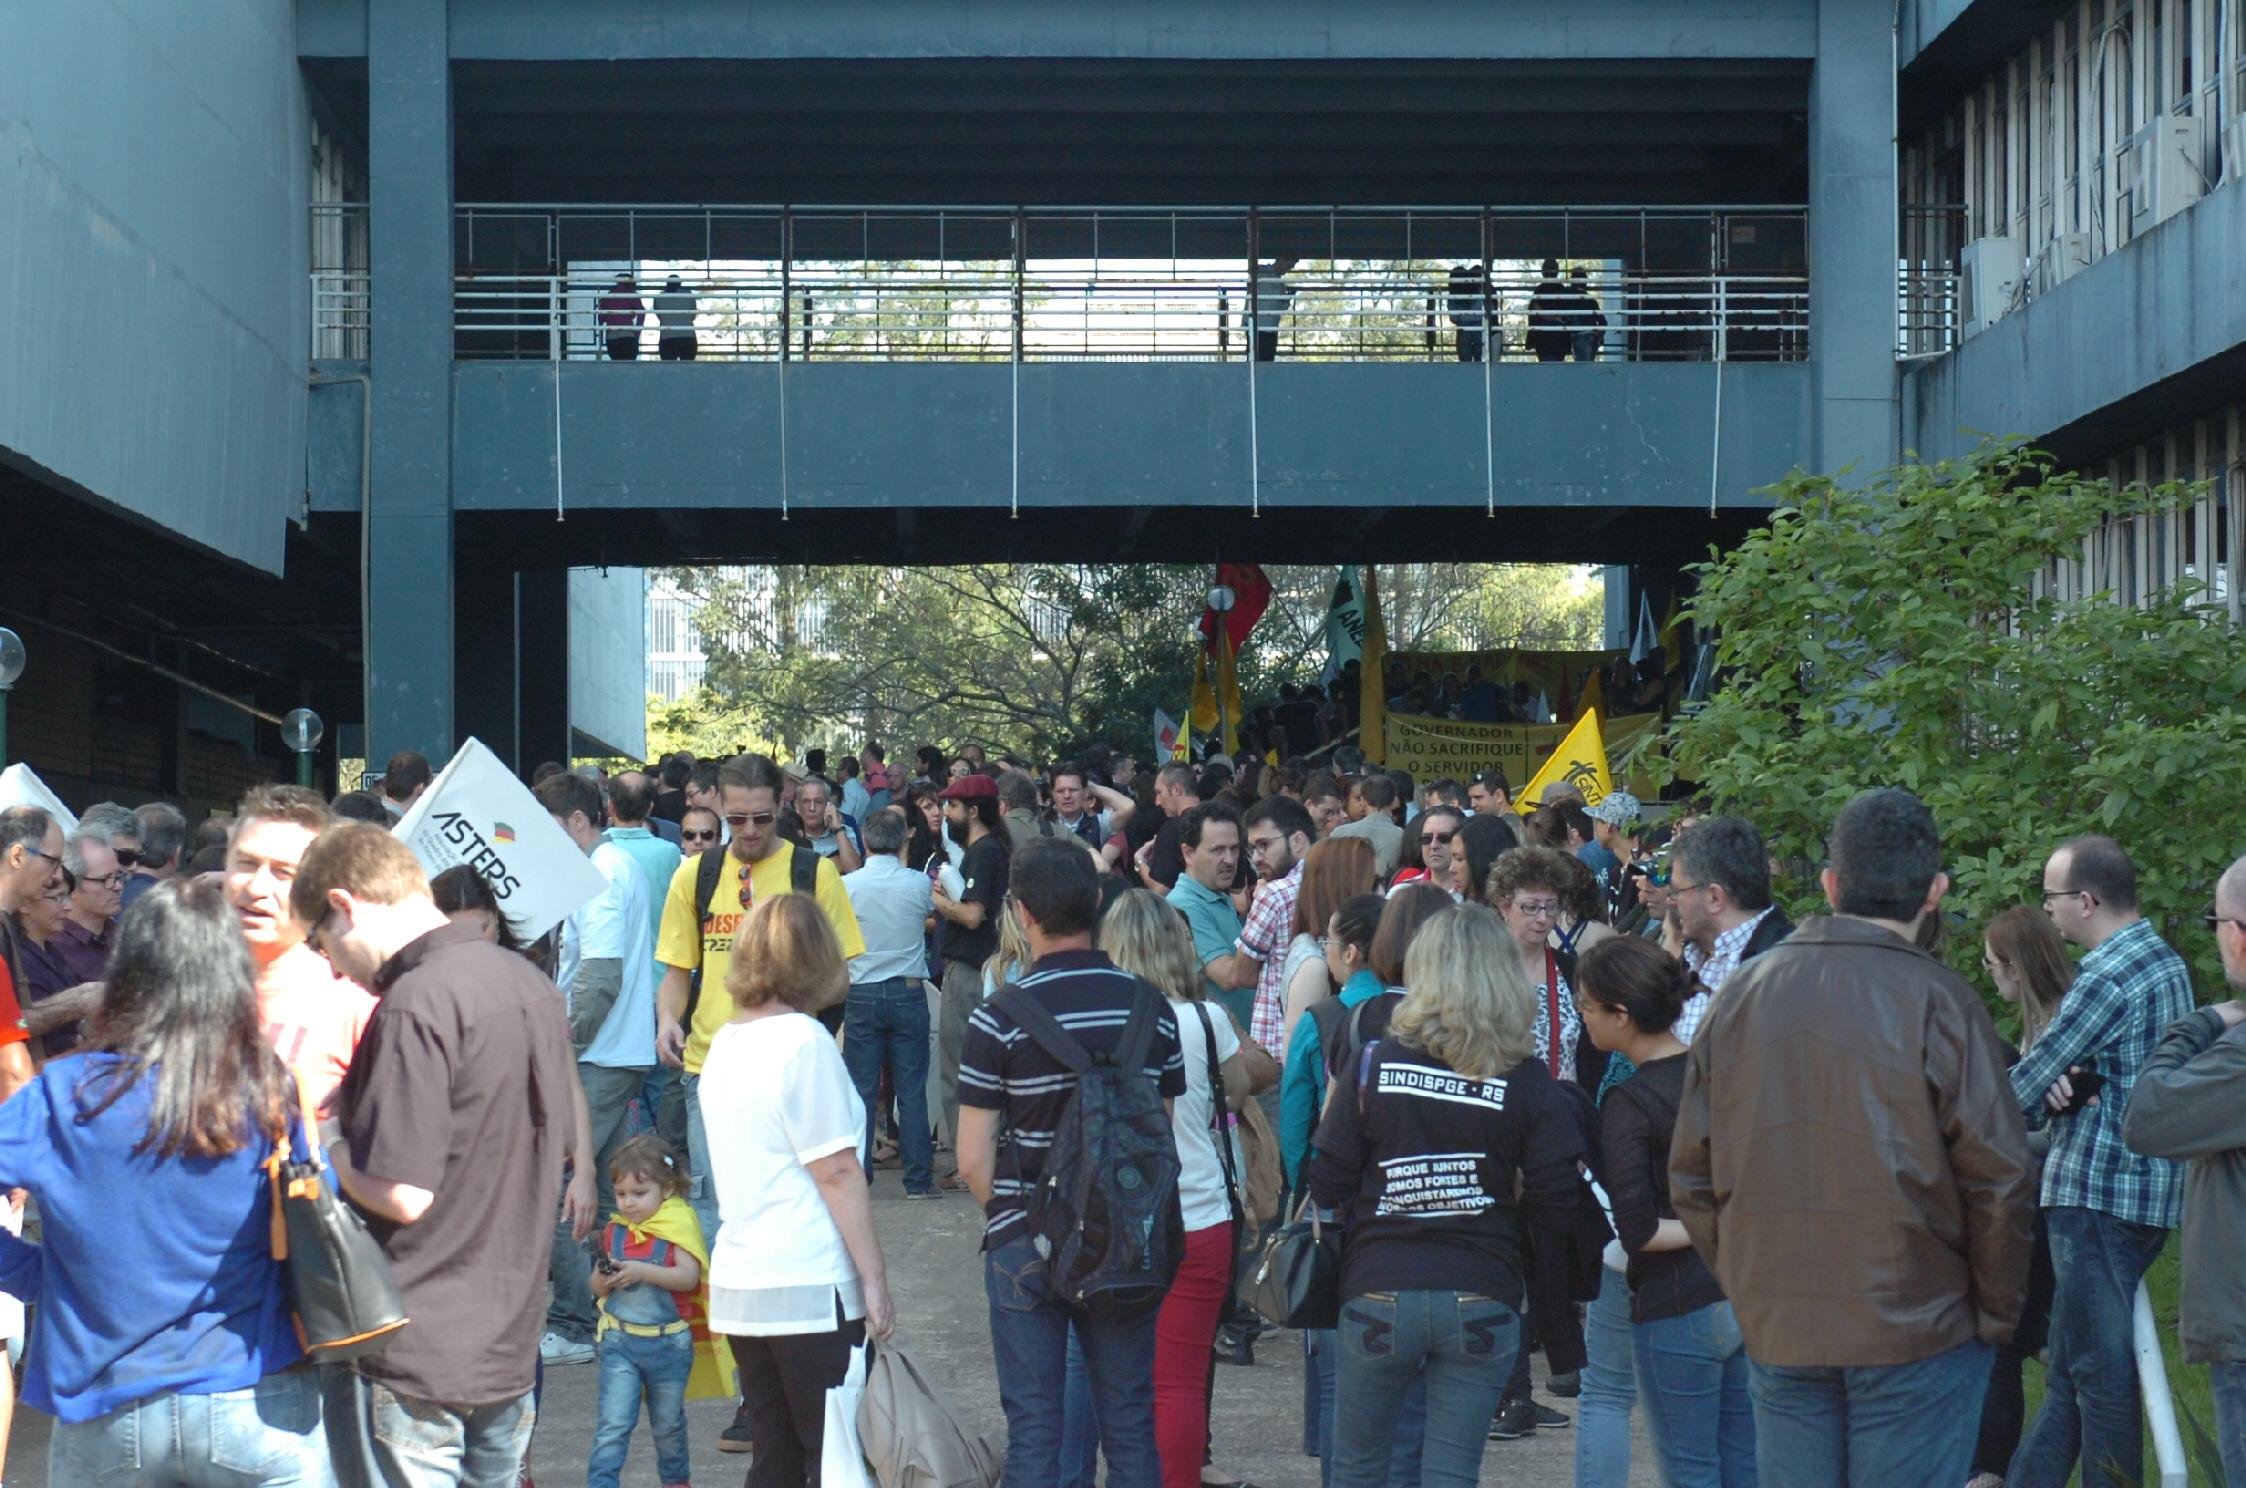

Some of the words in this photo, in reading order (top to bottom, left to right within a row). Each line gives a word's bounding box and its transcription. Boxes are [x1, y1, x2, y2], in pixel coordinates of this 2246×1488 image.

[1400, 724, 1513, 739] GOVERNADOR
[1390, 738, 1424, 755] NÃO
[1430, 743, 1524, 757] SACRIFIQUE
[1408, 761, 1419, 773] O
[1424, 761, 1505, 774] SERVIDOR
[432, 812, 521, 900] ASTERS
[1379, 1071, 1468, 1095] SINDISPGE
[1481, 1084, 1505, 1102] RS
[1469, 1174, 1479, 1184] E
